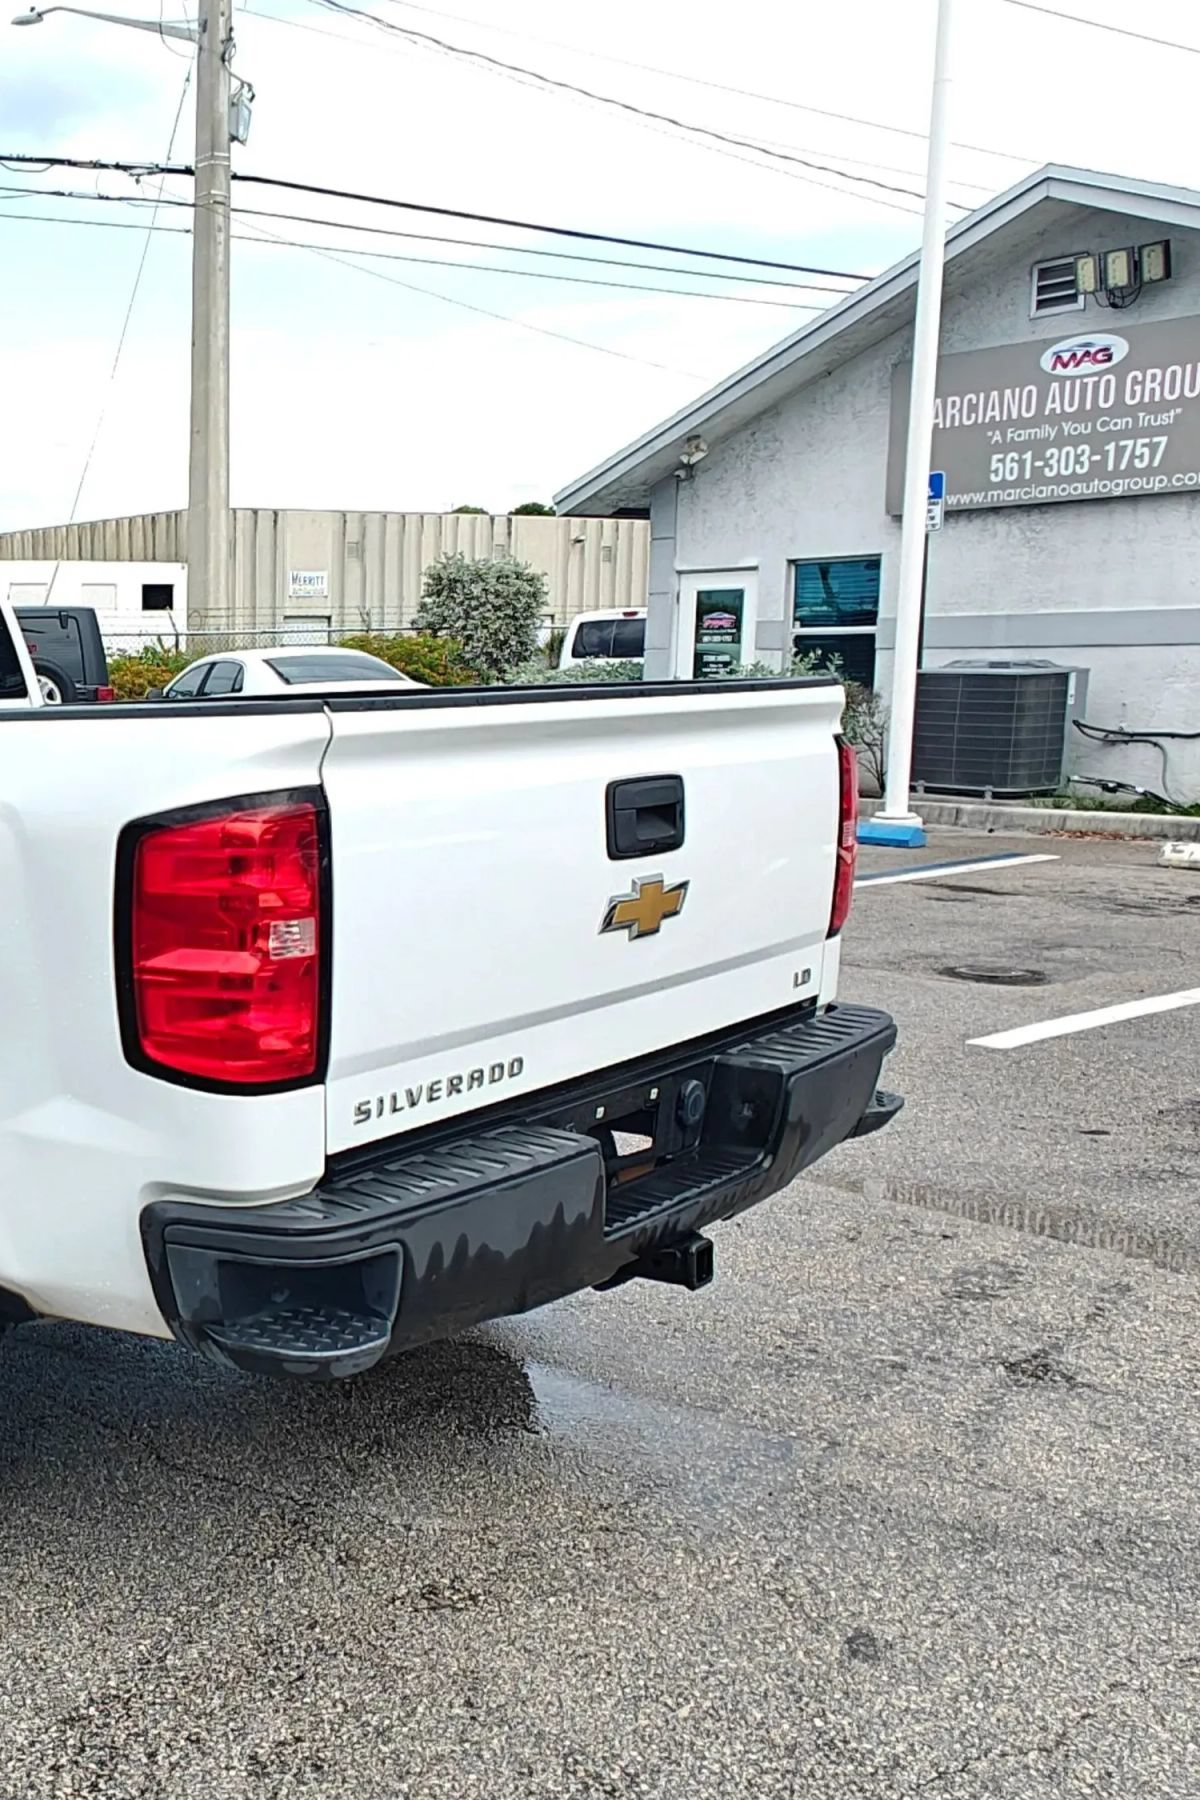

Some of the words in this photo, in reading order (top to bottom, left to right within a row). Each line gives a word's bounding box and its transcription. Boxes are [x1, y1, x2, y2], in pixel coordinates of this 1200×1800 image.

[1051, 346, 1113, 371] MAG
[932, 384, 1038, 429] ARCIANO
[1044, 374, 1116, 416] AUTO
[1124, 361, 1200, 406] GROU
[1006, 423, 1059, 442] Family
[1061, 420, 1092, 436] You
[1096, 416, 1133, 432] Can
[1137, 407, 1183, 428] Trust"
[989, 435, 1168, 483] 561-303-1757
[792, 967, 812, 989] LD
[353, 1055, 524, 1126] SILVERADO
